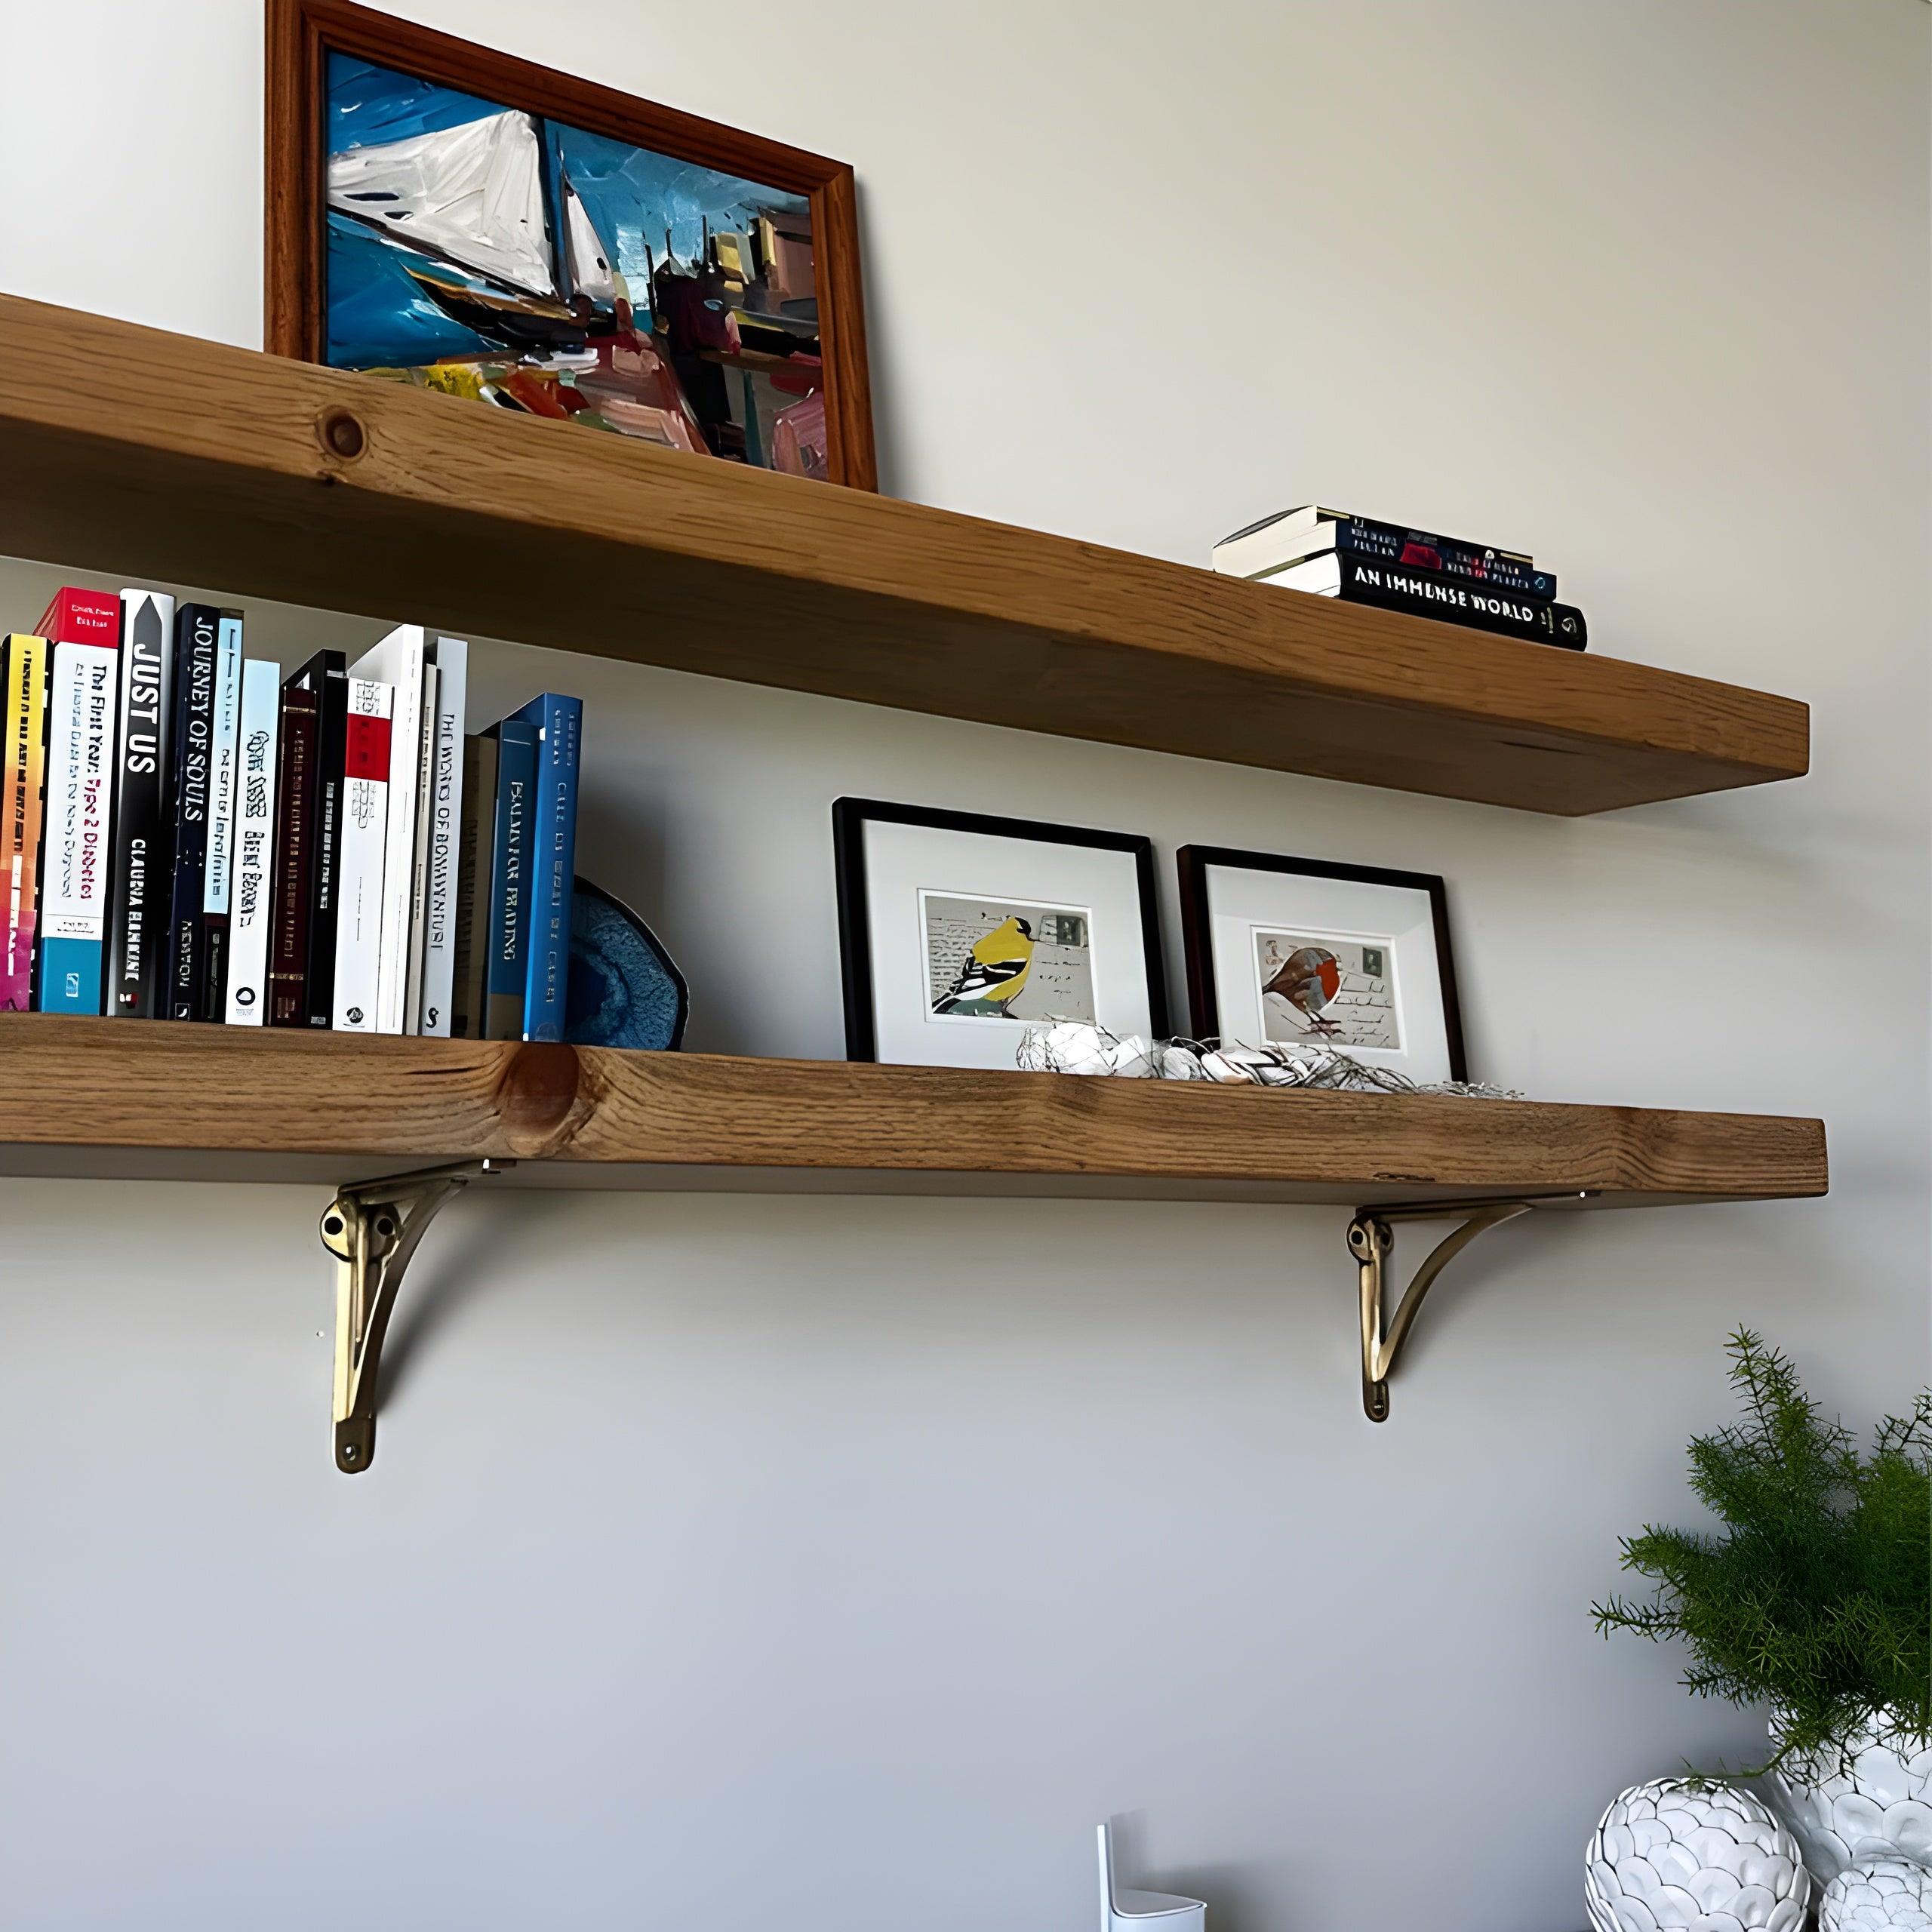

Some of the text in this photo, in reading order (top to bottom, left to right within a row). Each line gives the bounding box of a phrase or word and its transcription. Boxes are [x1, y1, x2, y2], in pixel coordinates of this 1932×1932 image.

[1355, 566, 1380, 586] AN
[1471, 594, 1534, 622] WORLD
[127, 643, 161, 774] JUST US
[184, 617, 214, 821] JOURNEY OF SOULS
